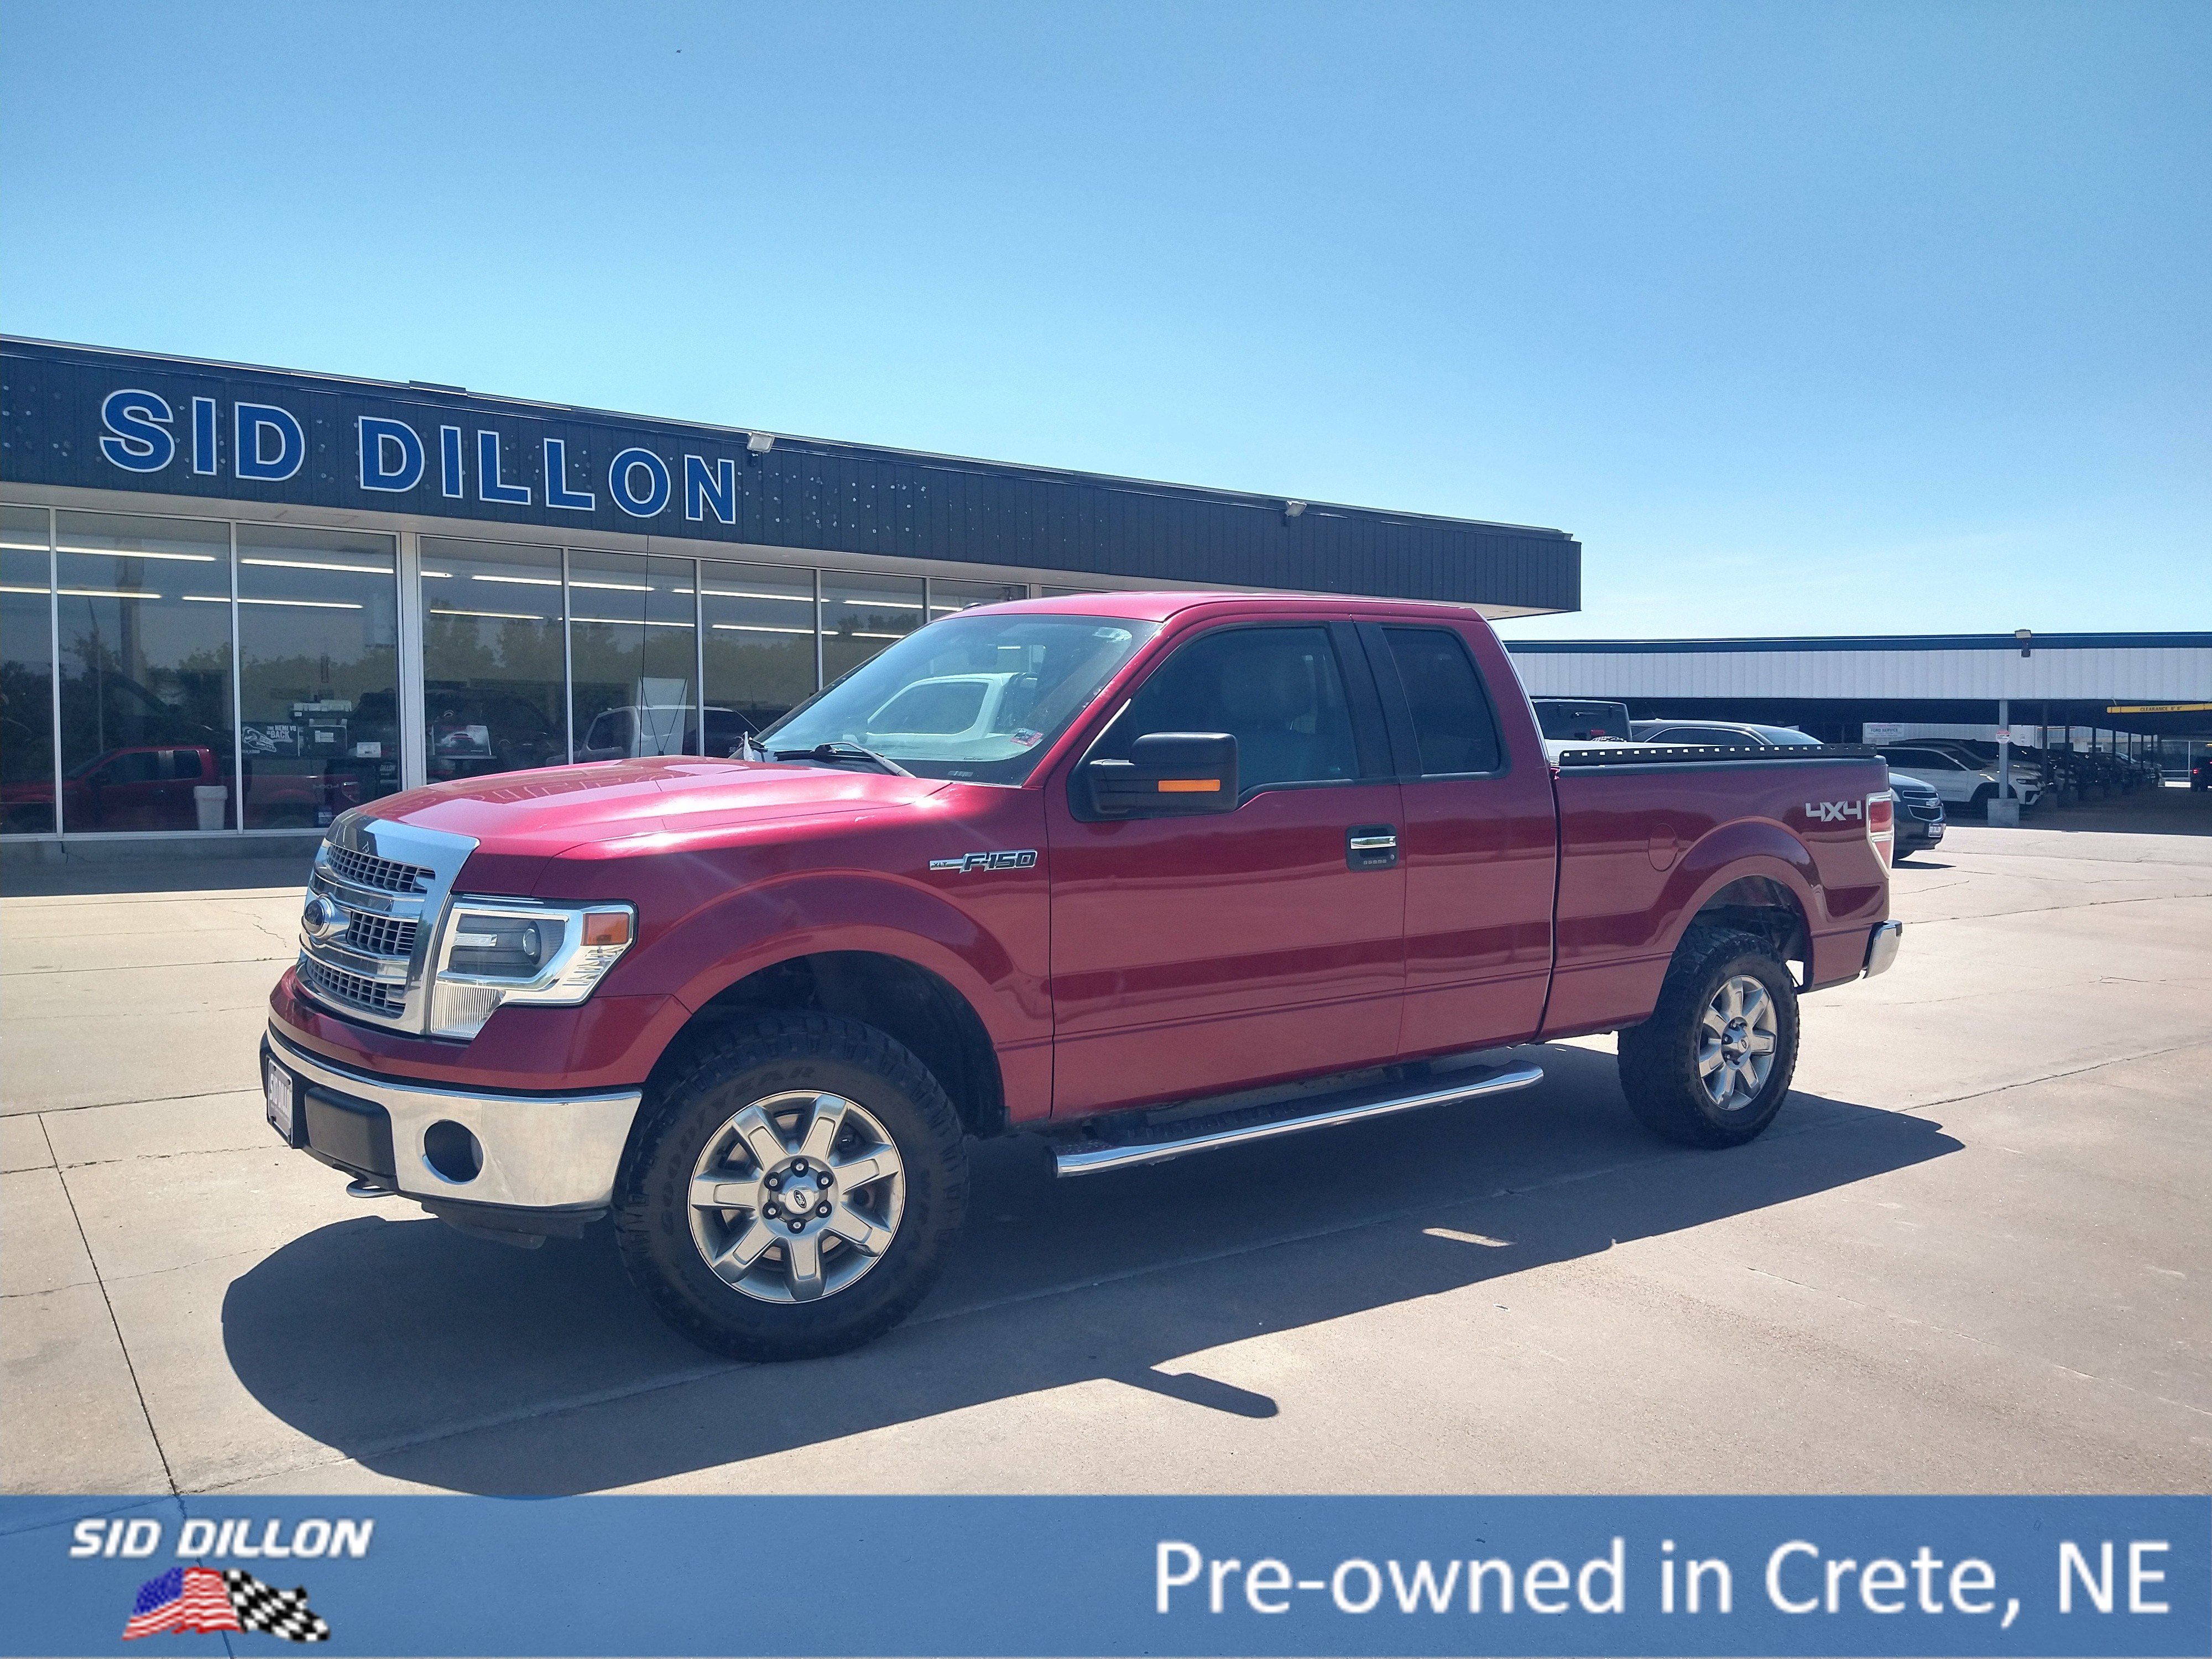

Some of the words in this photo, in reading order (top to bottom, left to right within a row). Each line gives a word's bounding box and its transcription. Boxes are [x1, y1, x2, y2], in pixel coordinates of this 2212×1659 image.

[99, 389, 306, 482] SID
[358, 416, 736, 525] DILLON
[270, 731, 290, 739] BACK
[959, 849, 1038, 874] F-150
